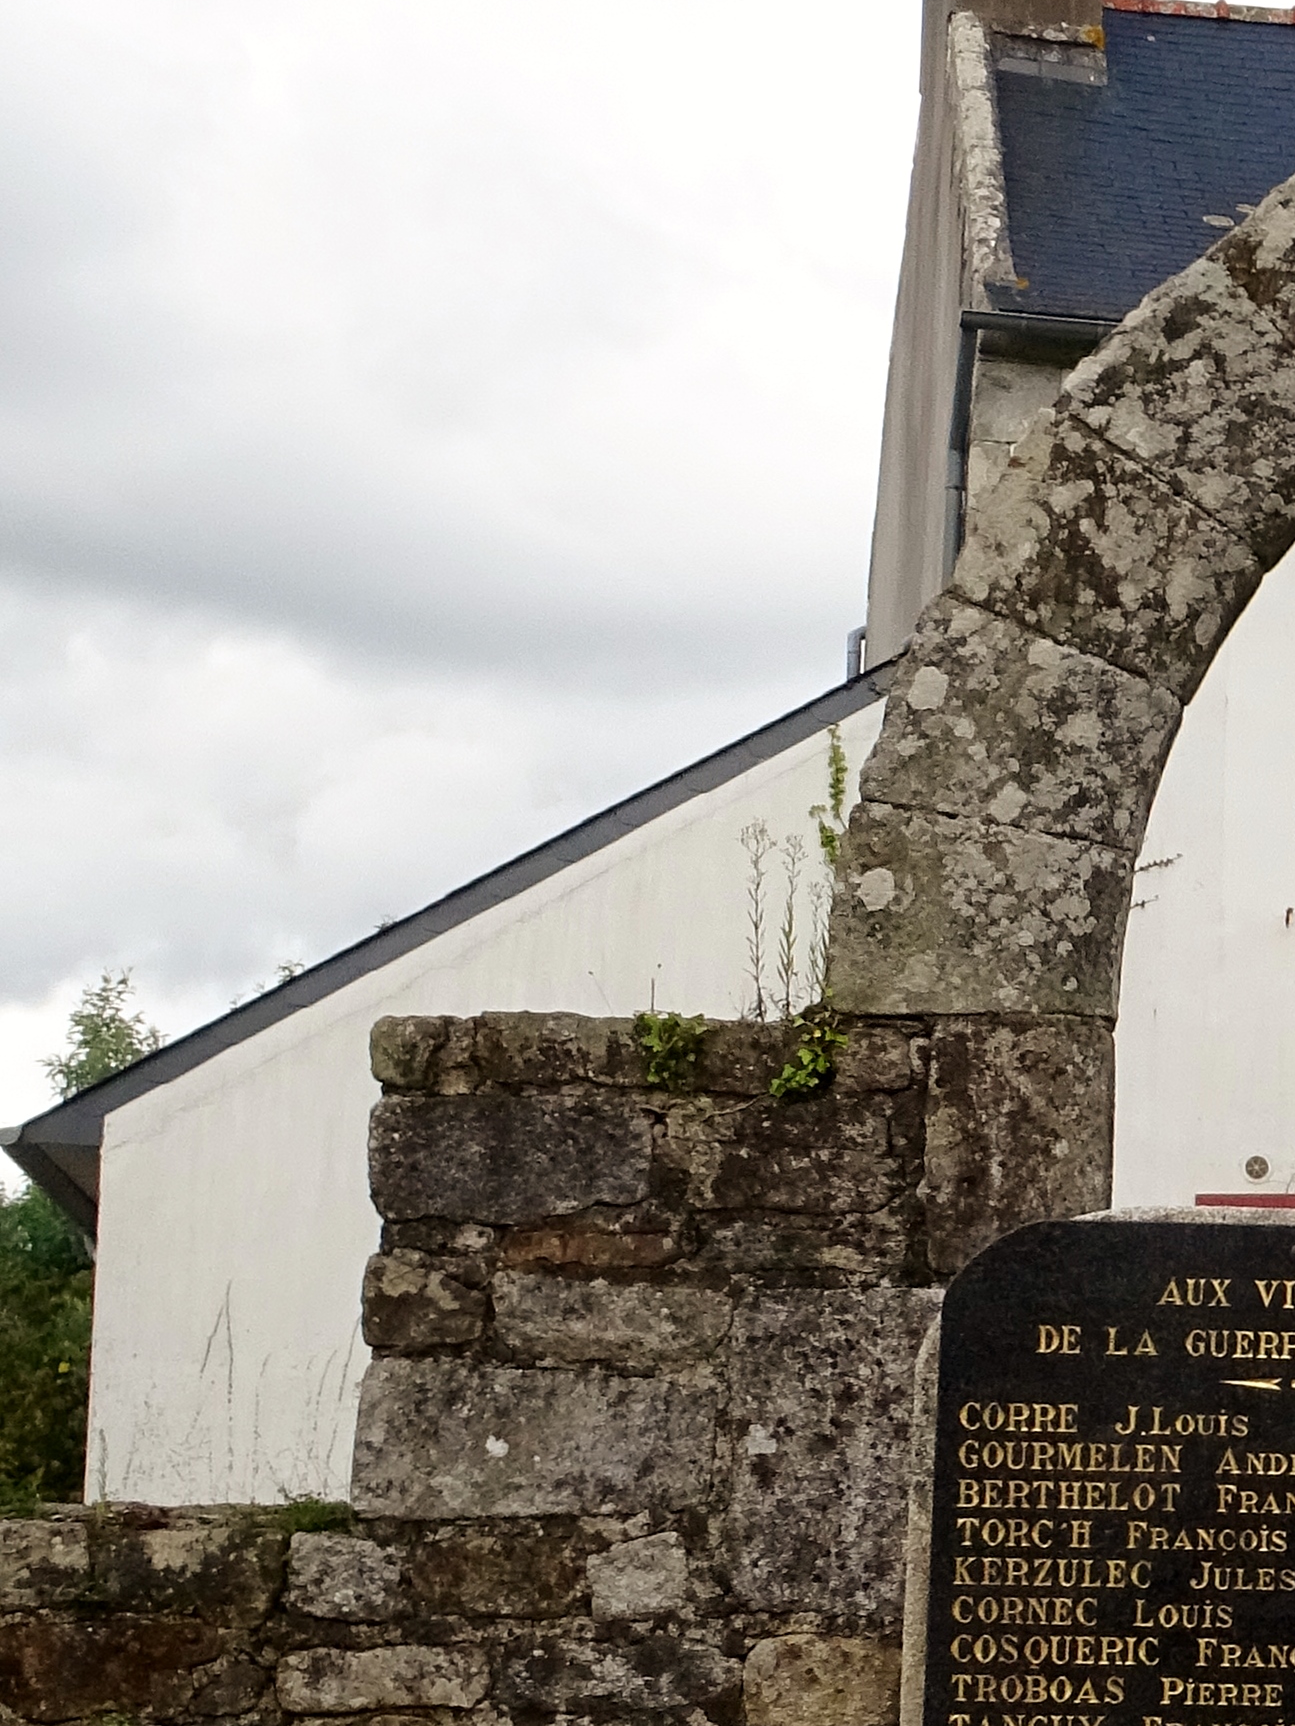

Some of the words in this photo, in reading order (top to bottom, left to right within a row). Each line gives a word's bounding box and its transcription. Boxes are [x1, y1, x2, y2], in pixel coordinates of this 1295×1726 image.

[1158, 1278, 1231, 1306] AUX
[1037, 1325, 1081, 1354] DE
[1106, 1327, 1157, 1356] LA
[959, 1402, 1078, 1432] CORRE
[959, 1440, 1182, 1473] GOURMELEN
[957, 1479, 1180, 1511] BERTHELOT
[954, 1557, 1151, 1588] KERZULEC
[952, 1596, 1097, 1626] CORNEC
[951, 1634, 1159, 1668] COSQUERIC
[952, 1674, 1123, 1704] TROBOAS
